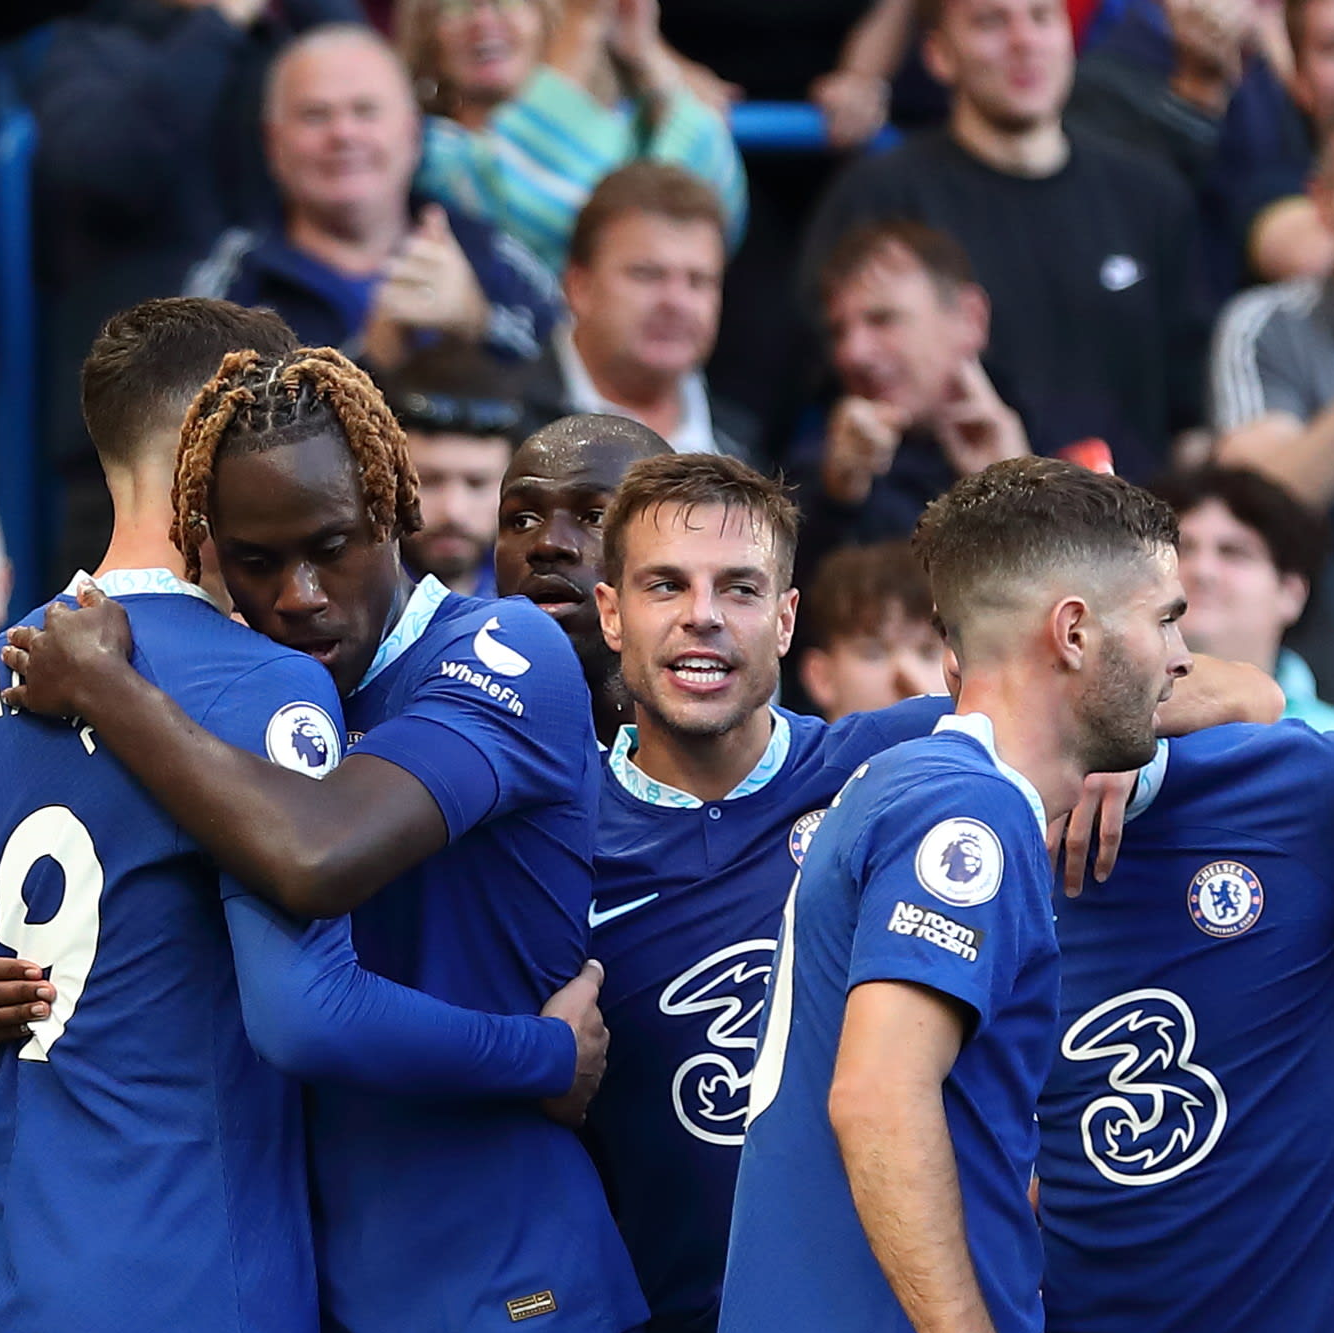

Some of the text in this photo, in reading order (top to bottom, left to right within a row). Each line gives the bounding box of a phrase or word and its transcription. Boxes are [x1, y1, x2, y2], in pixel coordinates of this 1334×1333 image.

[440, 660, 525, 717] WhaleFin
[1195, 863, 1244, 886] CHELSEA
[891, 901, 975, 946] No room
[917, 924, 978, 962] racism
[1061, 987, 1228, 1187] 3
